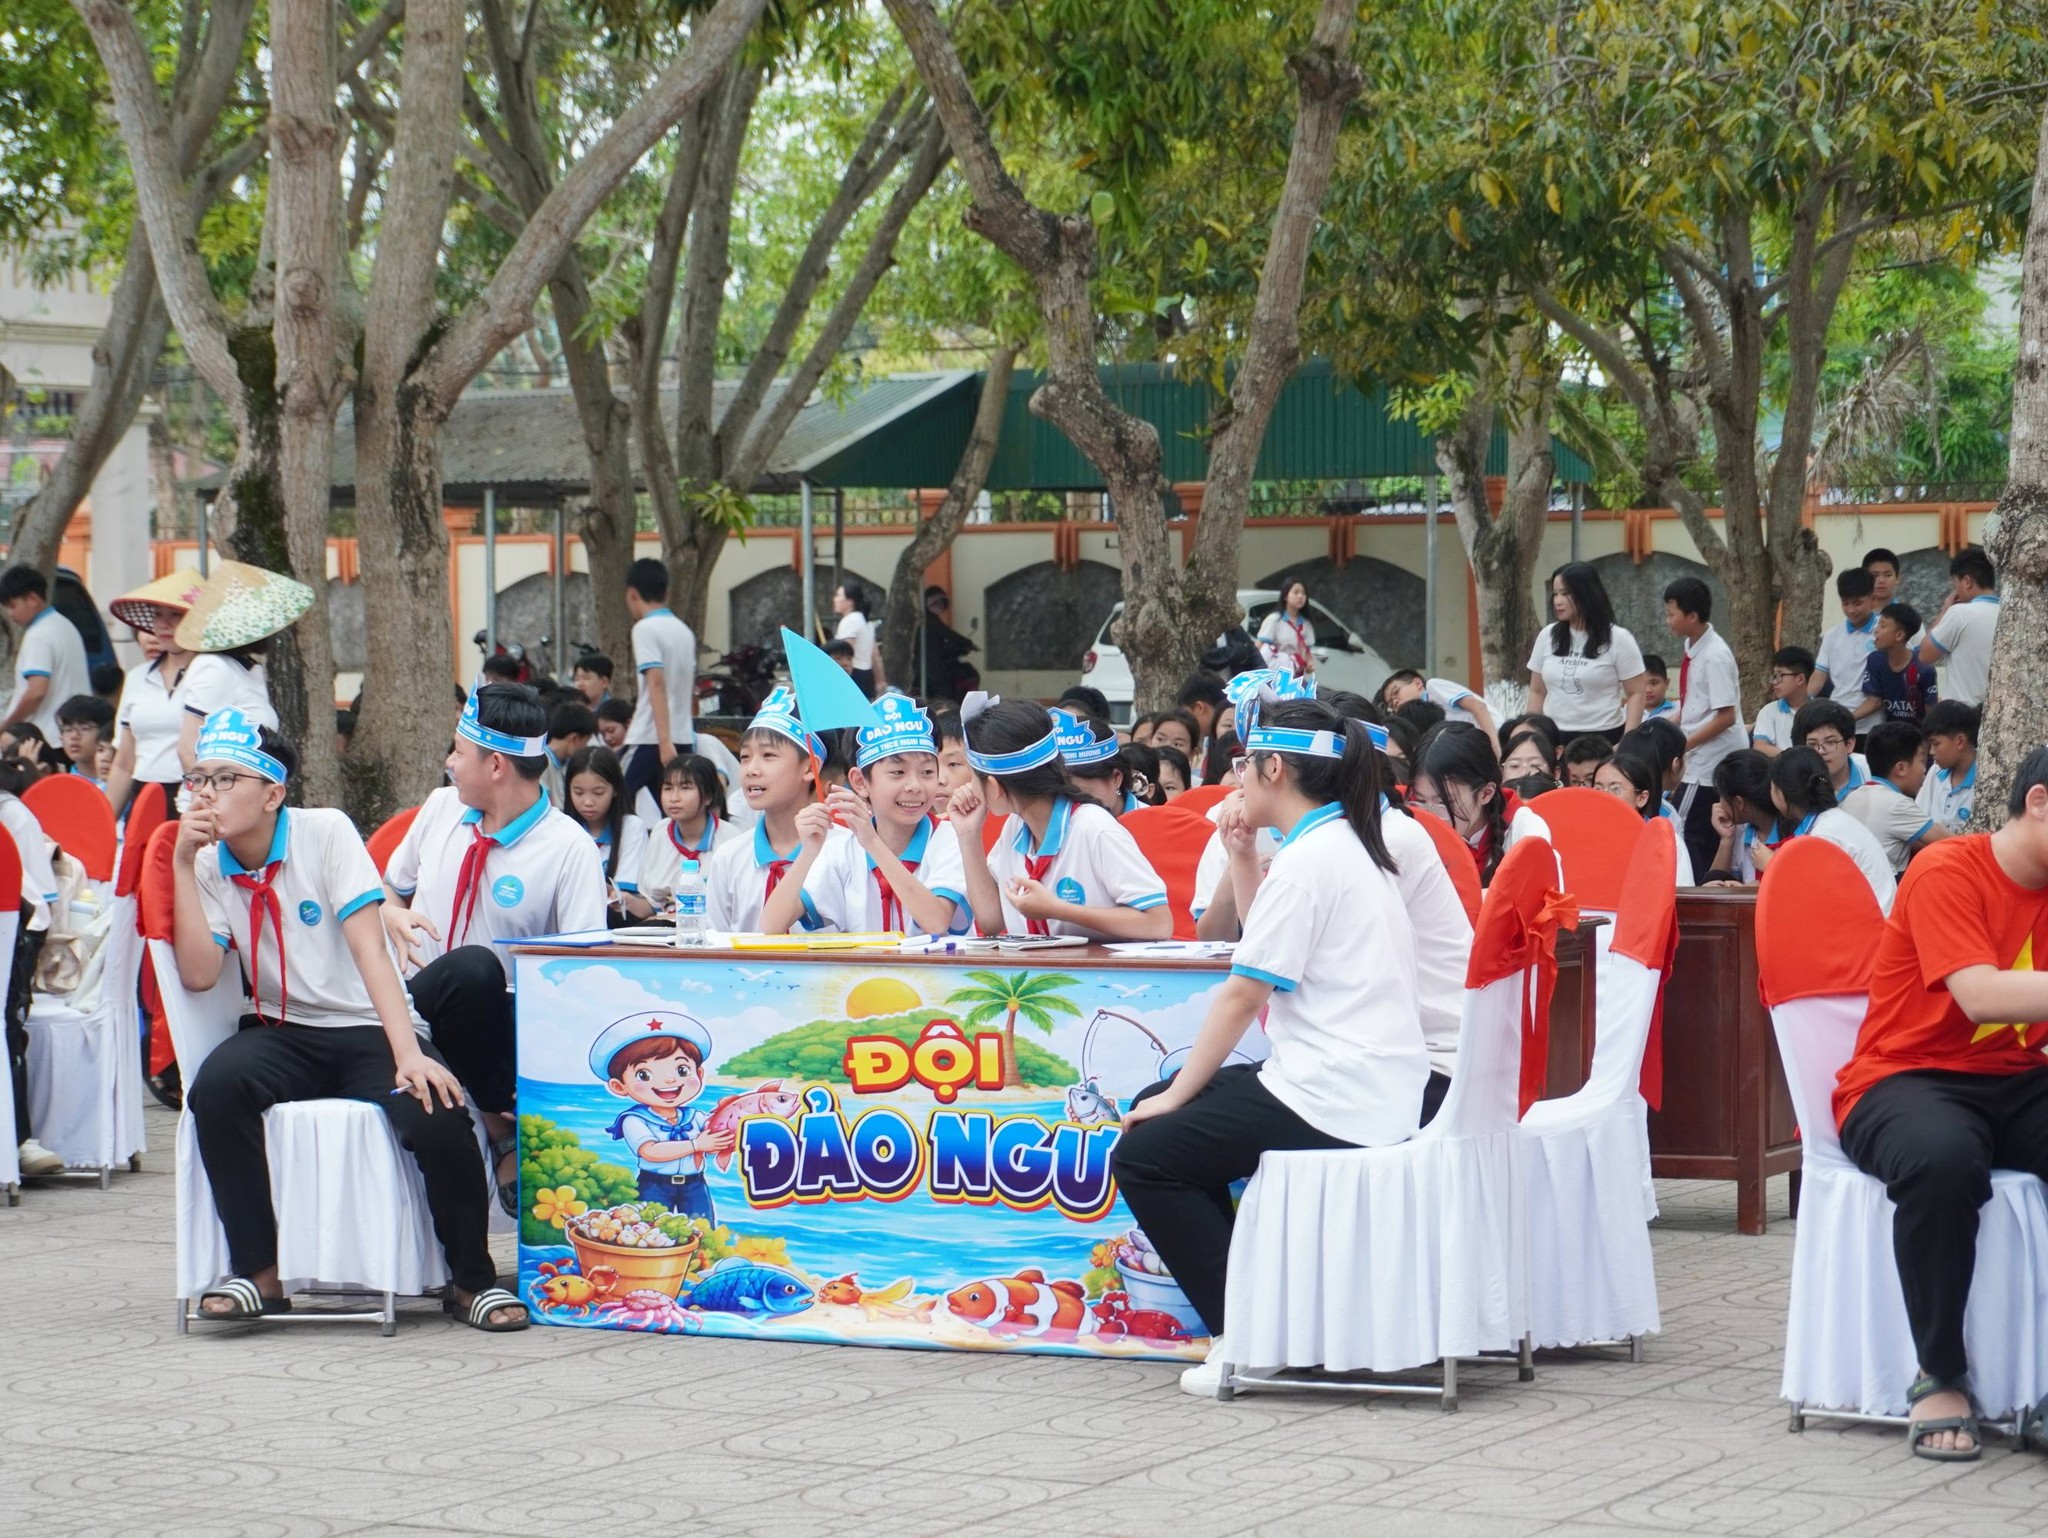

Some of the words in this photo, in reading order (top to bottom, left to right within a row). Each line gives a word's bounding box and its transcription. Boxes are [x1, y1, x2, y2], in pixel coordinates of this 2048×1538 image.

[1559, 658, 1588, 667] Archive
[1057, 734, 1085, 746] NGƯ
[846, 1022, 1003, 1099] ĐỘI
[743, 1085, 918, 1198] ĐẢO
[928, 1110, 1123, 1209] NGƯ
